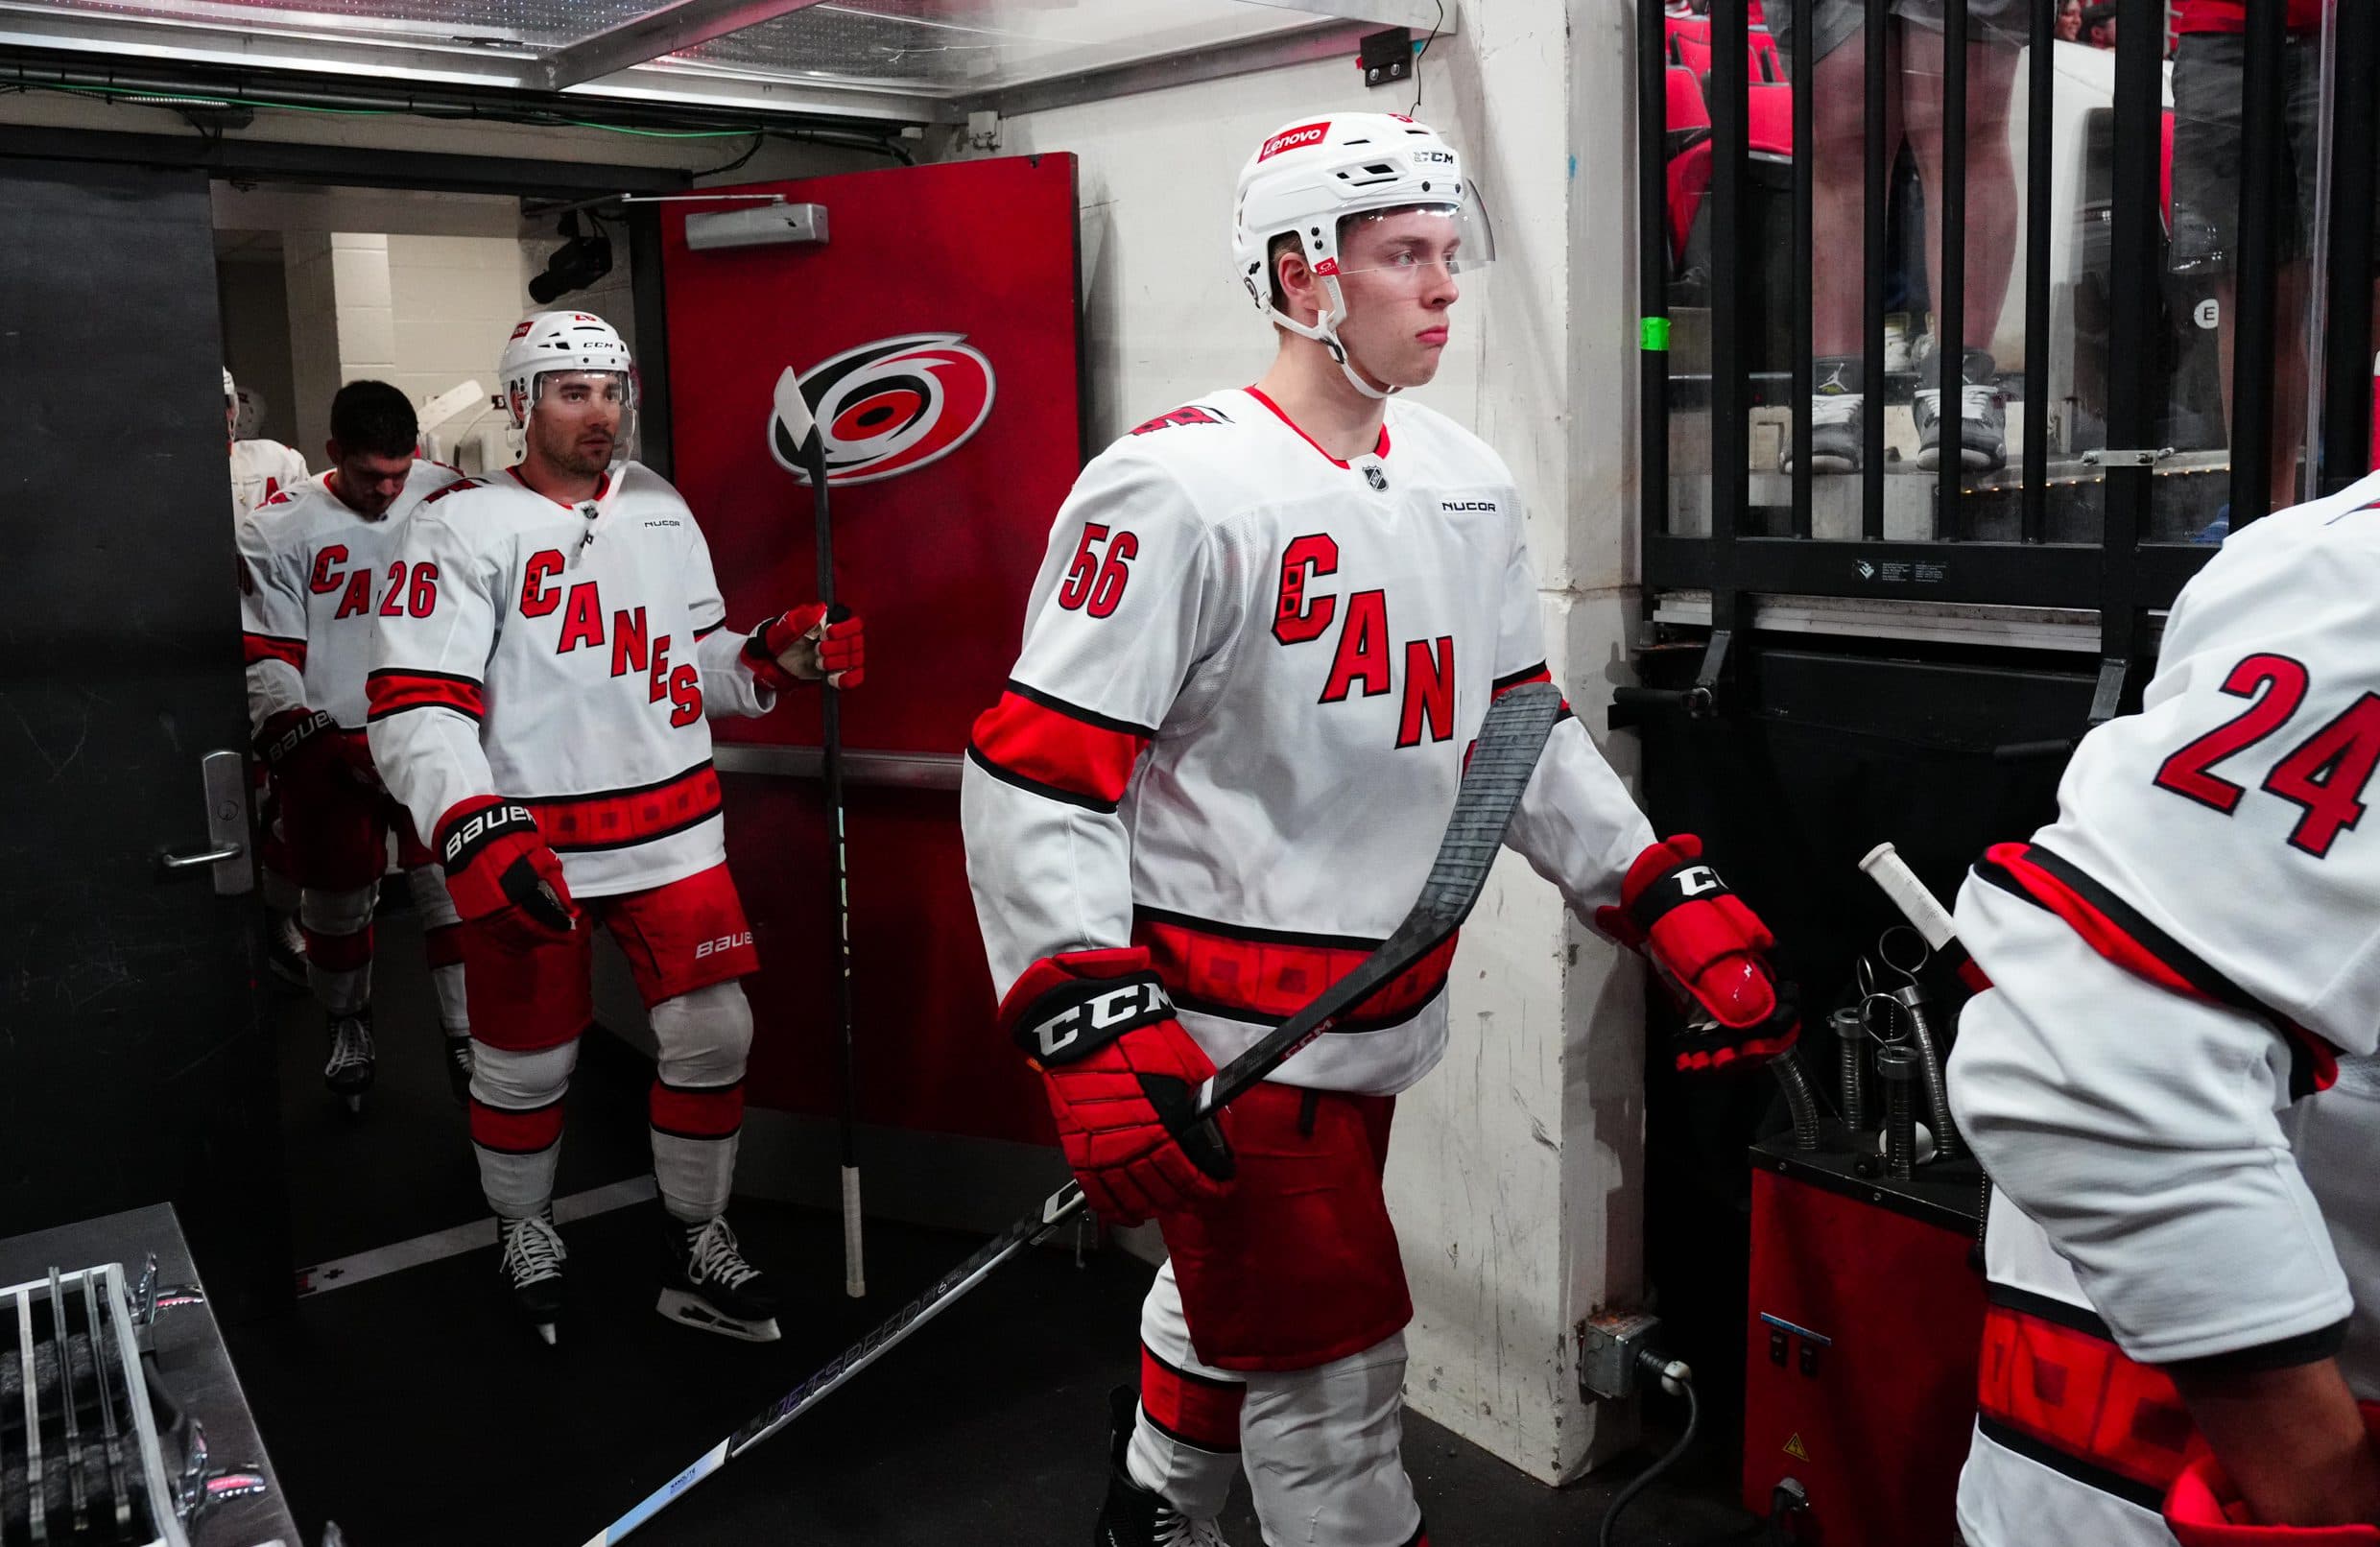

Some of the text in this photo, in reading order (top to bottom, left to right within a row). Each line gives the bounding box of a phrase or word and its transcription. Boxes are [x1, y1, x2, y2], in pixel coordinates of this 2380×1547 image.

[1262, 129, 1321, 156] Lenovo
[1414, 152, 1453, 164] CCM
[2204, 307, 2215, 321] E
[1441, 502, 1496, 512] NUCOR
[309, 543, 381, 621] CA
[379, 560, 439, 619] 26
[1059, 522, 1139, 619] 56
[519, 549, 702, 729] CANES
[1271, 533, 1472, 777] CAN
[2153, 653, 2380, 860] 24
[1033, 983, 1176, 1057] CCM
